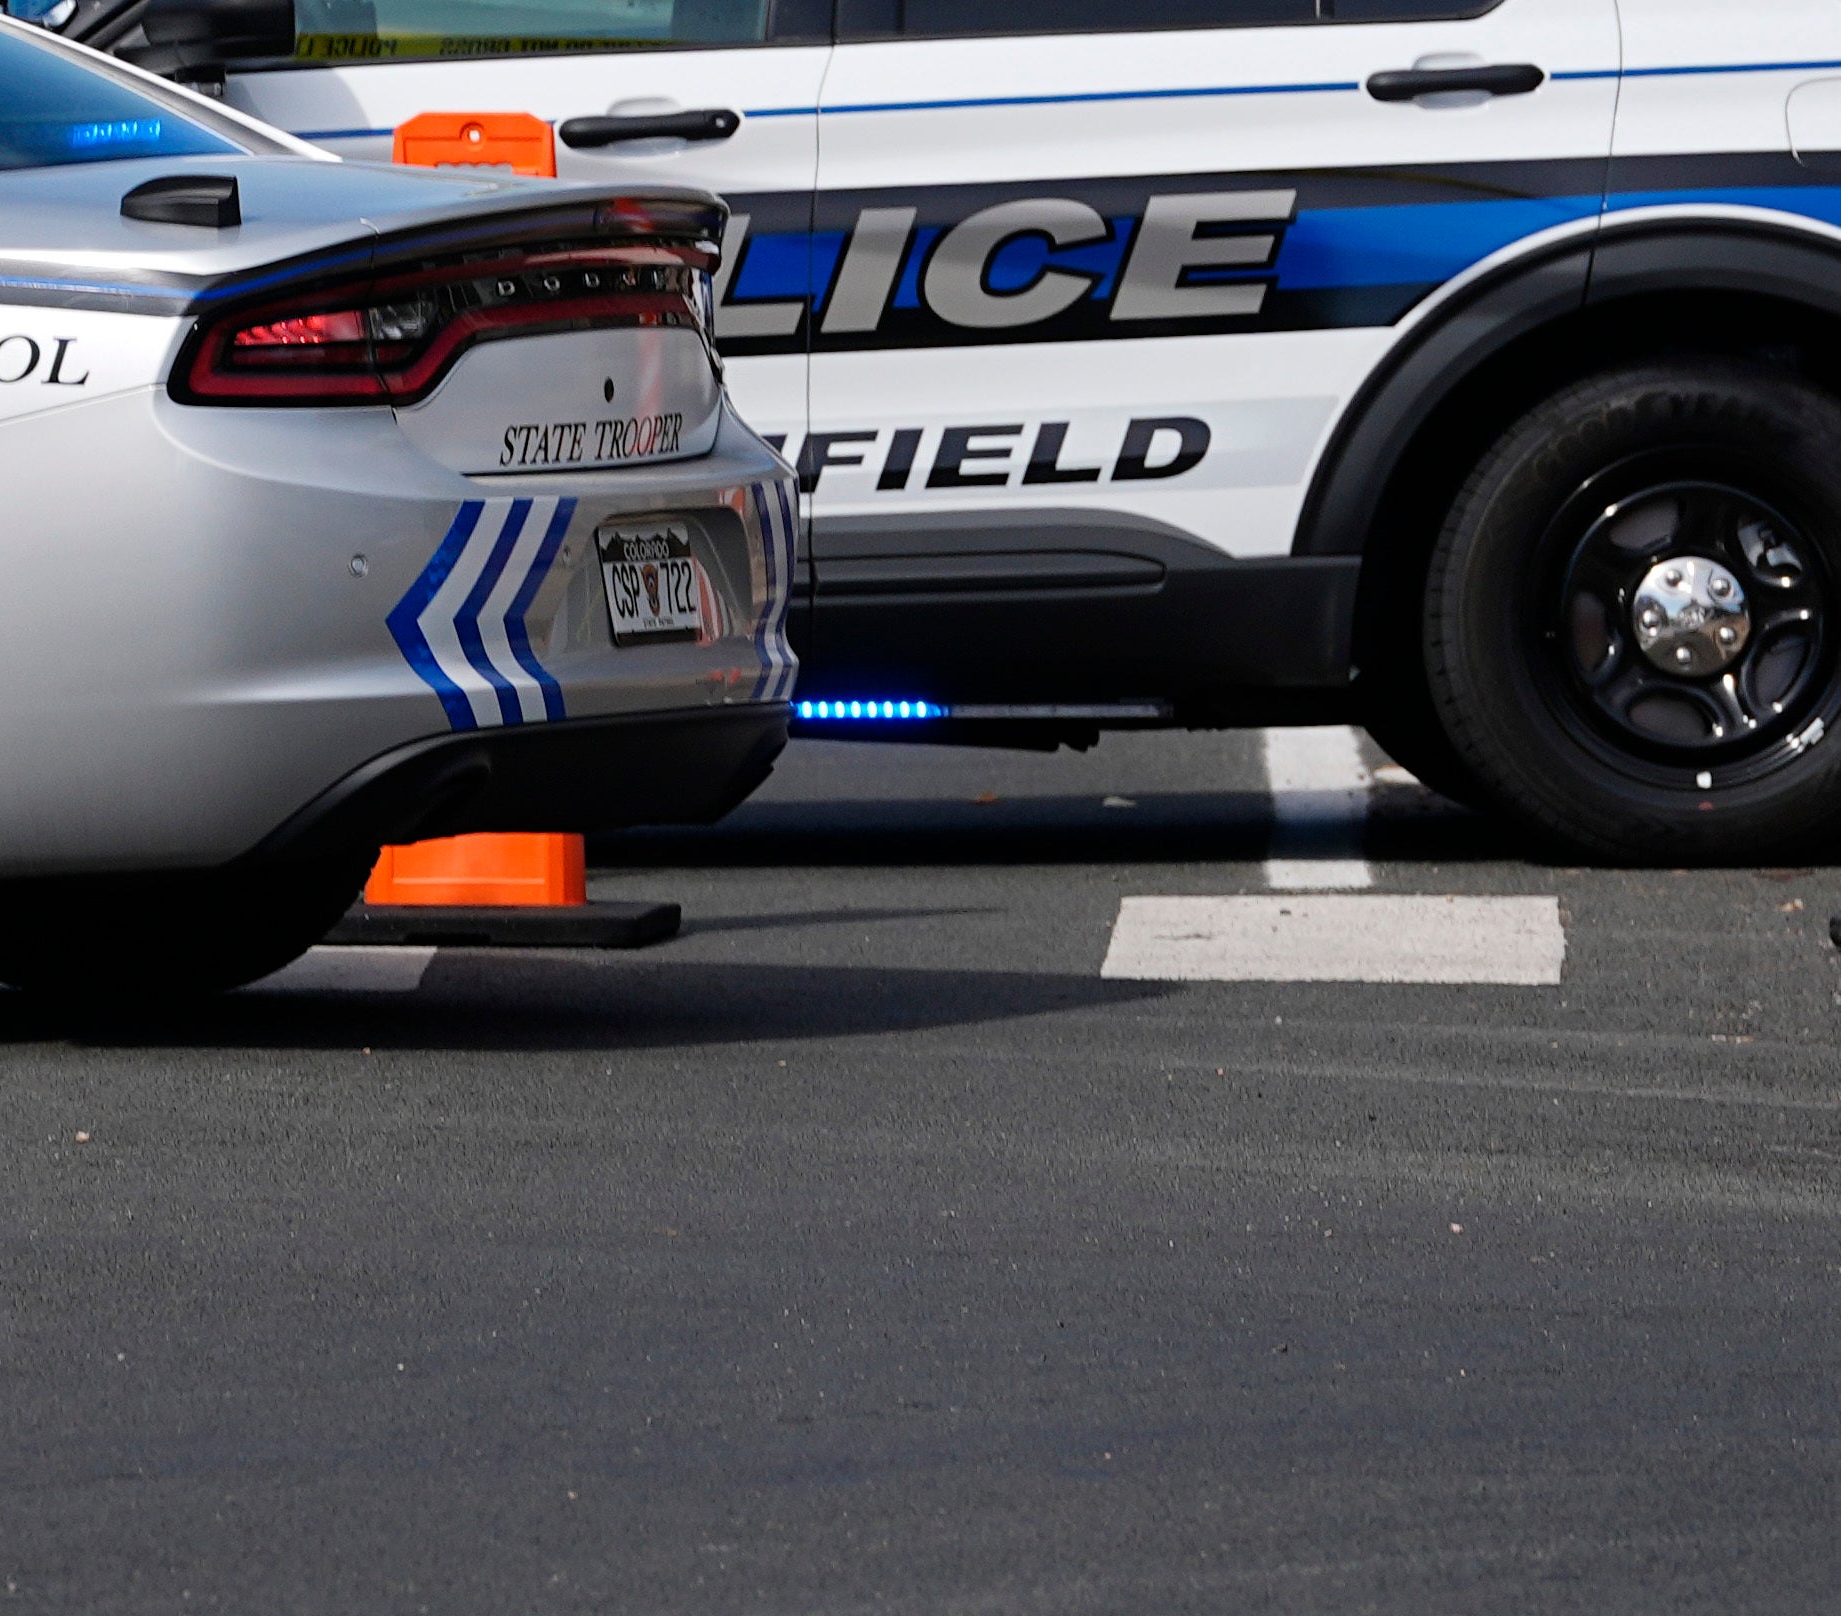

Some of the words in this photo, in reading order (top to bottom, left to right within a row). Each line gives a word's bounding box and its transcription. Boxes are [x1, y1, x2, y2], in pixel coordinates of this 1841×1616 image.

[499, 422, 586, 467] STATE
[595, 413, 683, 462] TROOPER
[763, 417, 1213, 493] FIELD
[624, 540, 670, 561] COLORADO
[612, 562, 640, 618] CSP
[659, 560, 697, 614] 722
